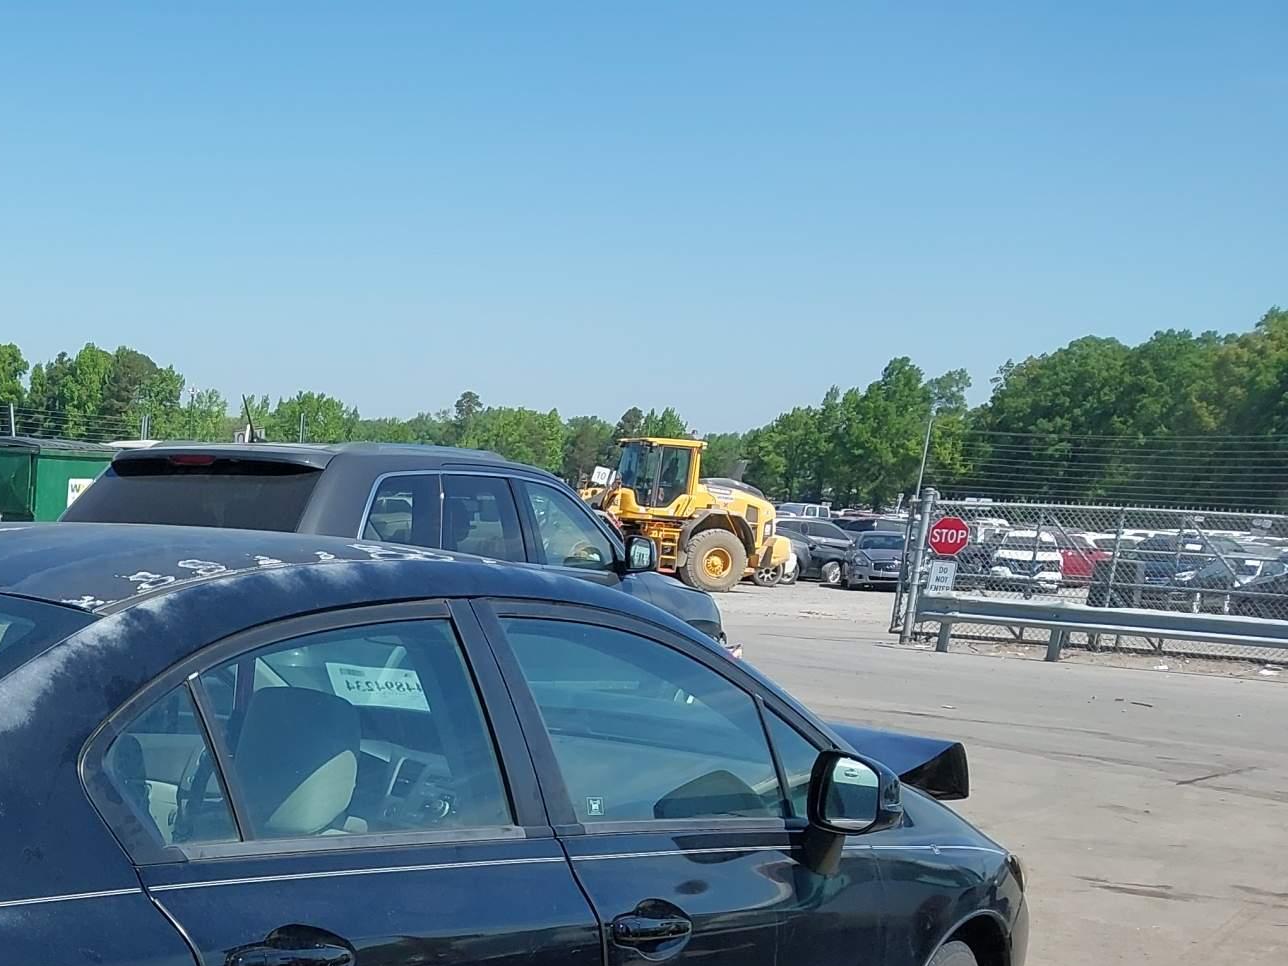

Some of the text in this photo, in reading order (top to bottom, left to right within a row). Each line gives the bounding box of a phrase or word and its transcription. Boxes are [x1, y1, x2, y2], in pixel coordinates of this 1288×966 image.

[596, 470, 607, 481] 10
[931, 528, 967, 544] STOP
[938, 566, 949, 574] DO
[935, 575, 949, 583] NOT
[929, 584, 951, 592] ENTER
